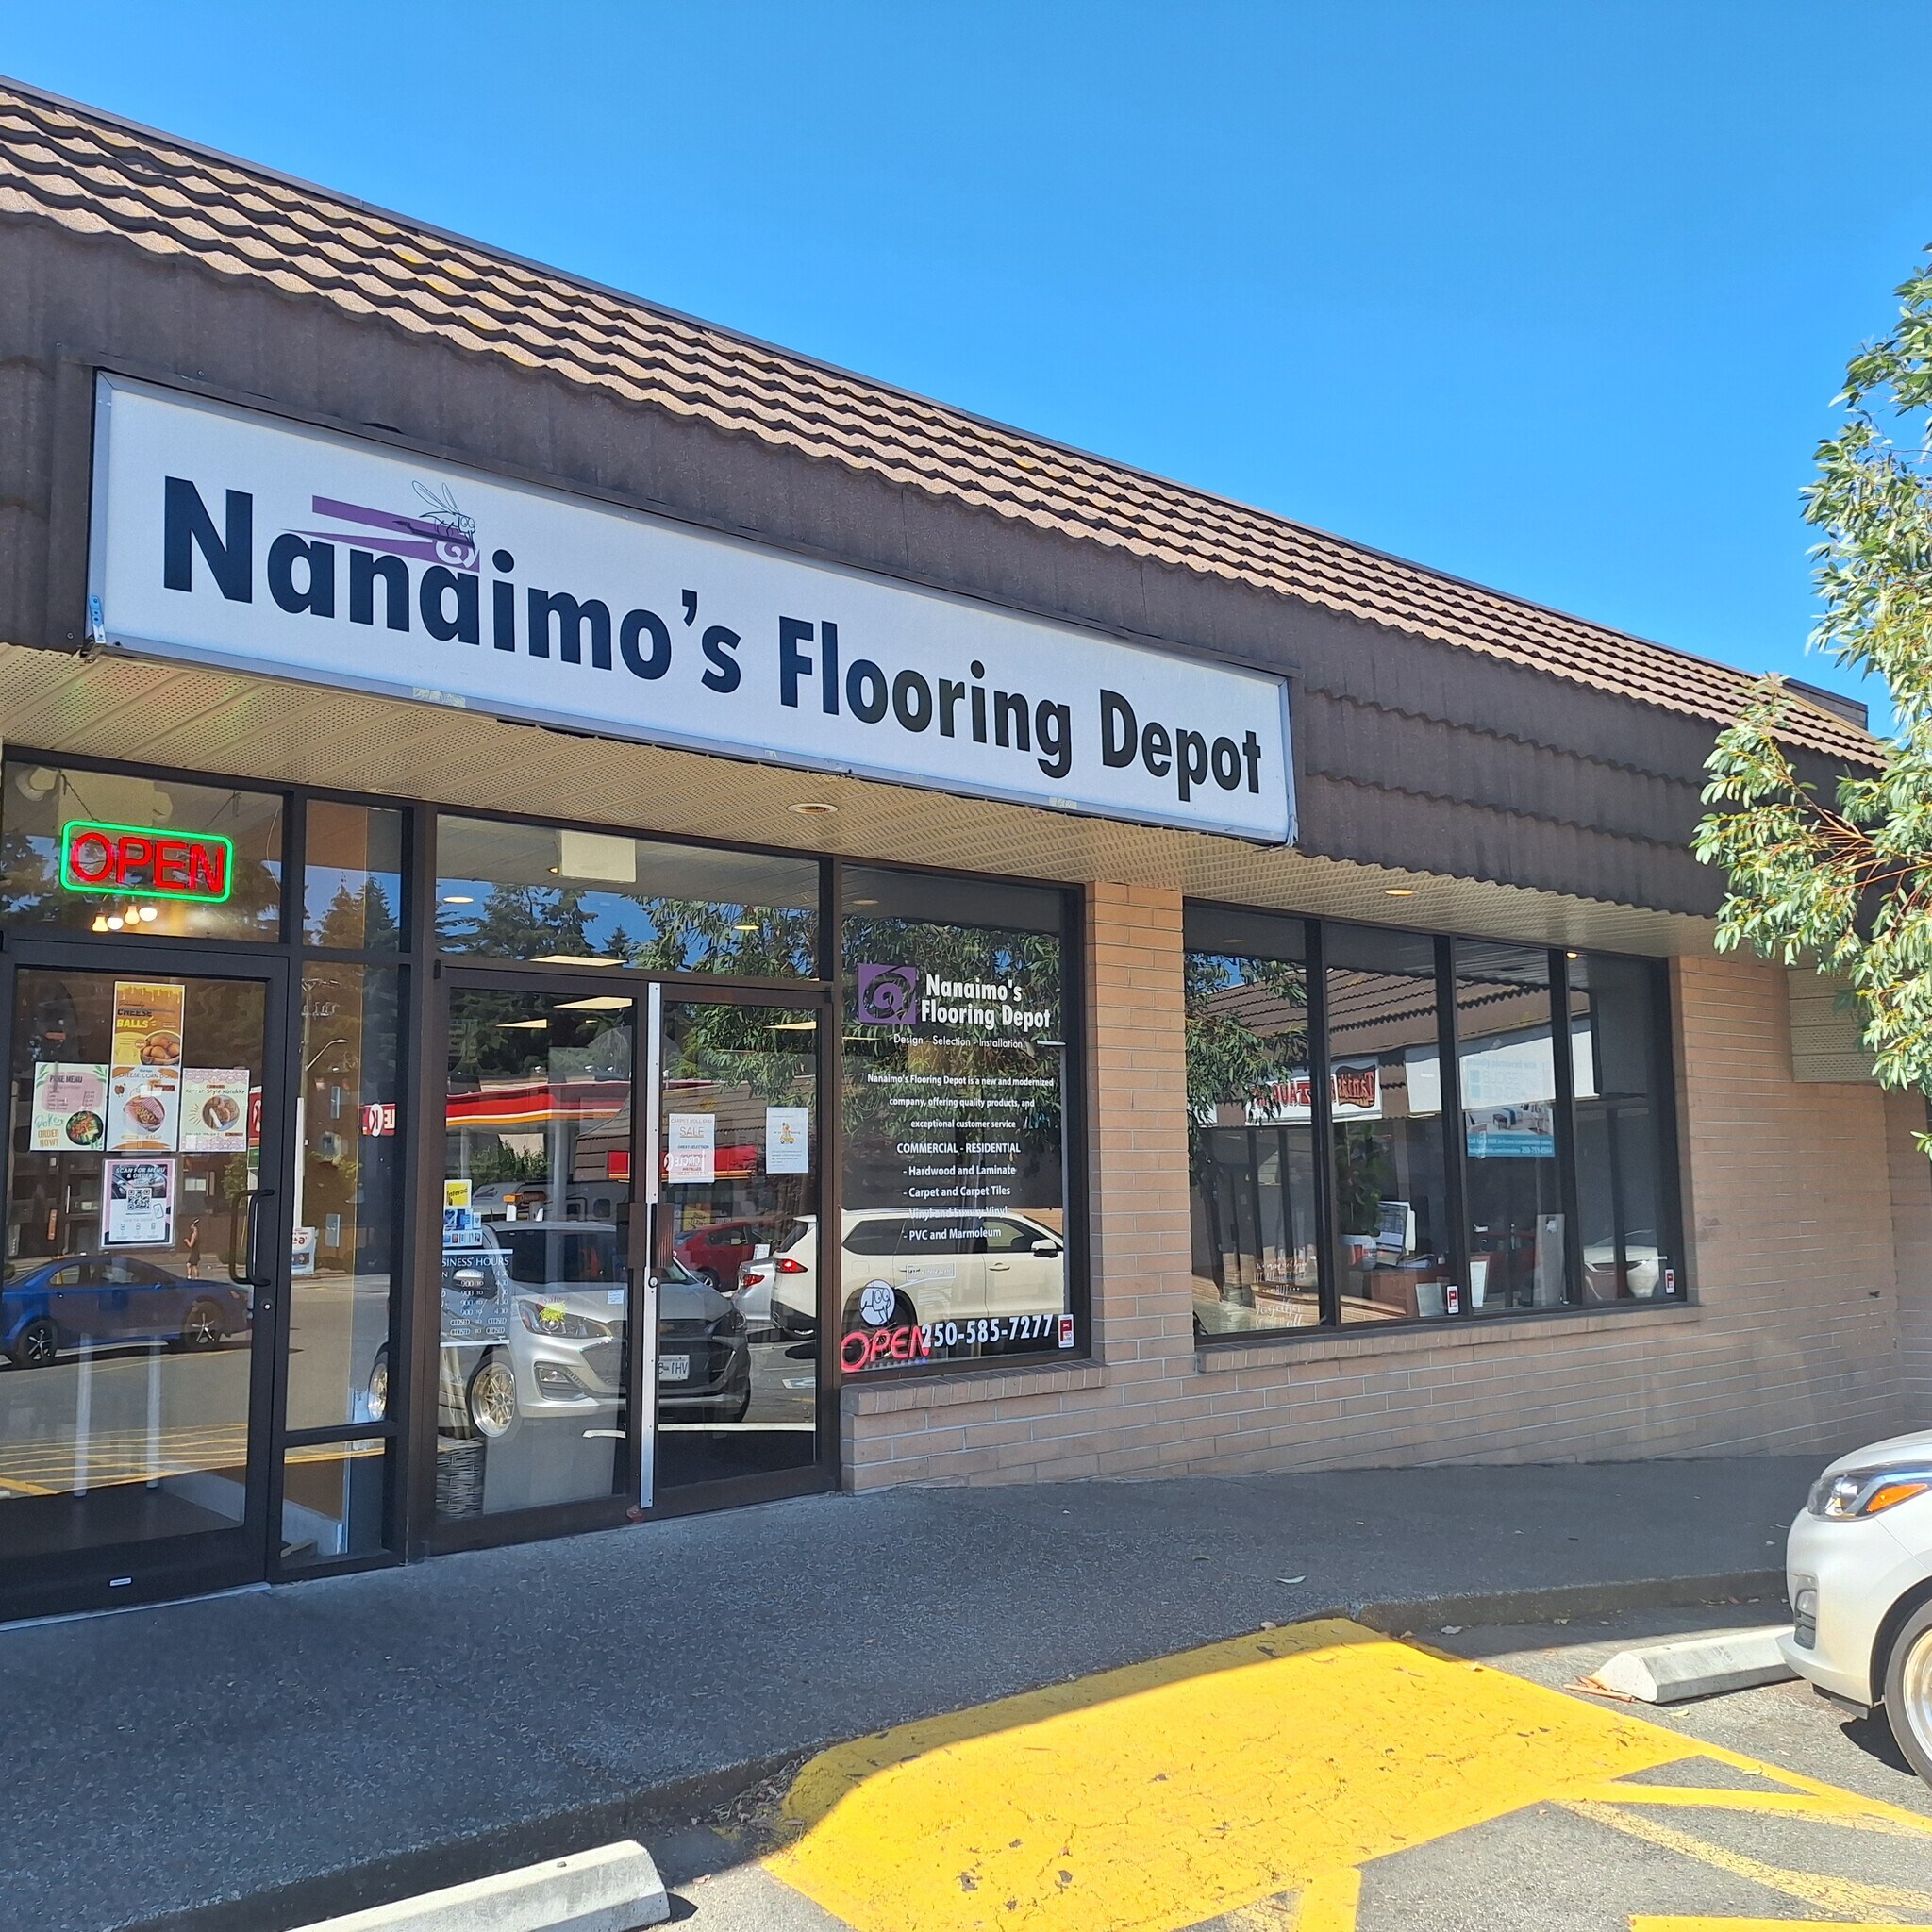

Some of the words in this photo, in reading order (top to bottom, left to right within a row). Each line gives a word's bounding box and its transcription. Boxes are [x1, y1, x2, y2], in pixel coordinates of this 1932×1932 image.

[164, 475, 741, 694] Nanaimo's
[778, 615, 1072, 779] Flooring
[1099, 689, 1262, 802] Depot
[70, 831, 225, 893] OPEN
[925, 974, 1023, 1002] Nanaimo's
[117, 1008, 153, 1017] CHEESE
[921, 999, 995, 1030] Flooring
[1002, 1008, 1051, 1032] Depot
[116, 1019, 150, 1029] BALLS
[893, 1034, 924, 1046] Design
[932, 1035, 971, 1047] Selection
[979, 1038, 1023, 1049] Installation
[65, 1075, 83, 1084] MENU
[867, 1073, 908, 1083] Nanaimo's
[909, 1074, 941, 1086] Flooring
[943, 1075, 967, 1086] Depot
[967, 1076, 973, 1086] is
[997, 1076, 1012, 1086] and
[1012, 1077, 1054, 1087] modernized
[889, 1098, 927, 1108] company,
[928, 1098, 958, 1108] offering
[959, 1098, 985, 1108] quality
[986, 1098, 1020, 1108] products,
[1021, 1099, 1035, 1108] and
[679, 1126, 705, 1136] SALE
[910, 1119, 955, 1130] exceptional
[956, 1120, 991, 1128] customer
[991, 1120, 1016, 1128] service
[38, 1129, 59, 1139] ORDER
[897, 1142, 958, 1154] COMMERCIAL
[966, 1142, 1021, 1154] RESIDENTIAL
[908, 1165, 956, 1176] Hardwood
[958, 1165, 974, 1175] and
[976, 1164, 1017, 1175] Laminate
[908, 1187, 939, 1200] Carpet
[941, 1186, 958, 1197] and
[959, 1186, 990, 1198] Carpet
[991, 1185, 1010, 1195] Tiles
[909, 1208, 930, 1221] Vinyl
[985, 1206, 1008, 1219] Vinyl
[908, 1230, 928, 1241] PVC
[930, 1229, 947, 1240] and
[949, 1227, 1001, 1239] Marmoleum
[441, 1257, 473, 1267] SINESS
[475, 1257, 509, 1266] HOURS
[921, 1313, 1054, 1348] 250-585-7277
[841, 1324, 931, 1373] OPEN
